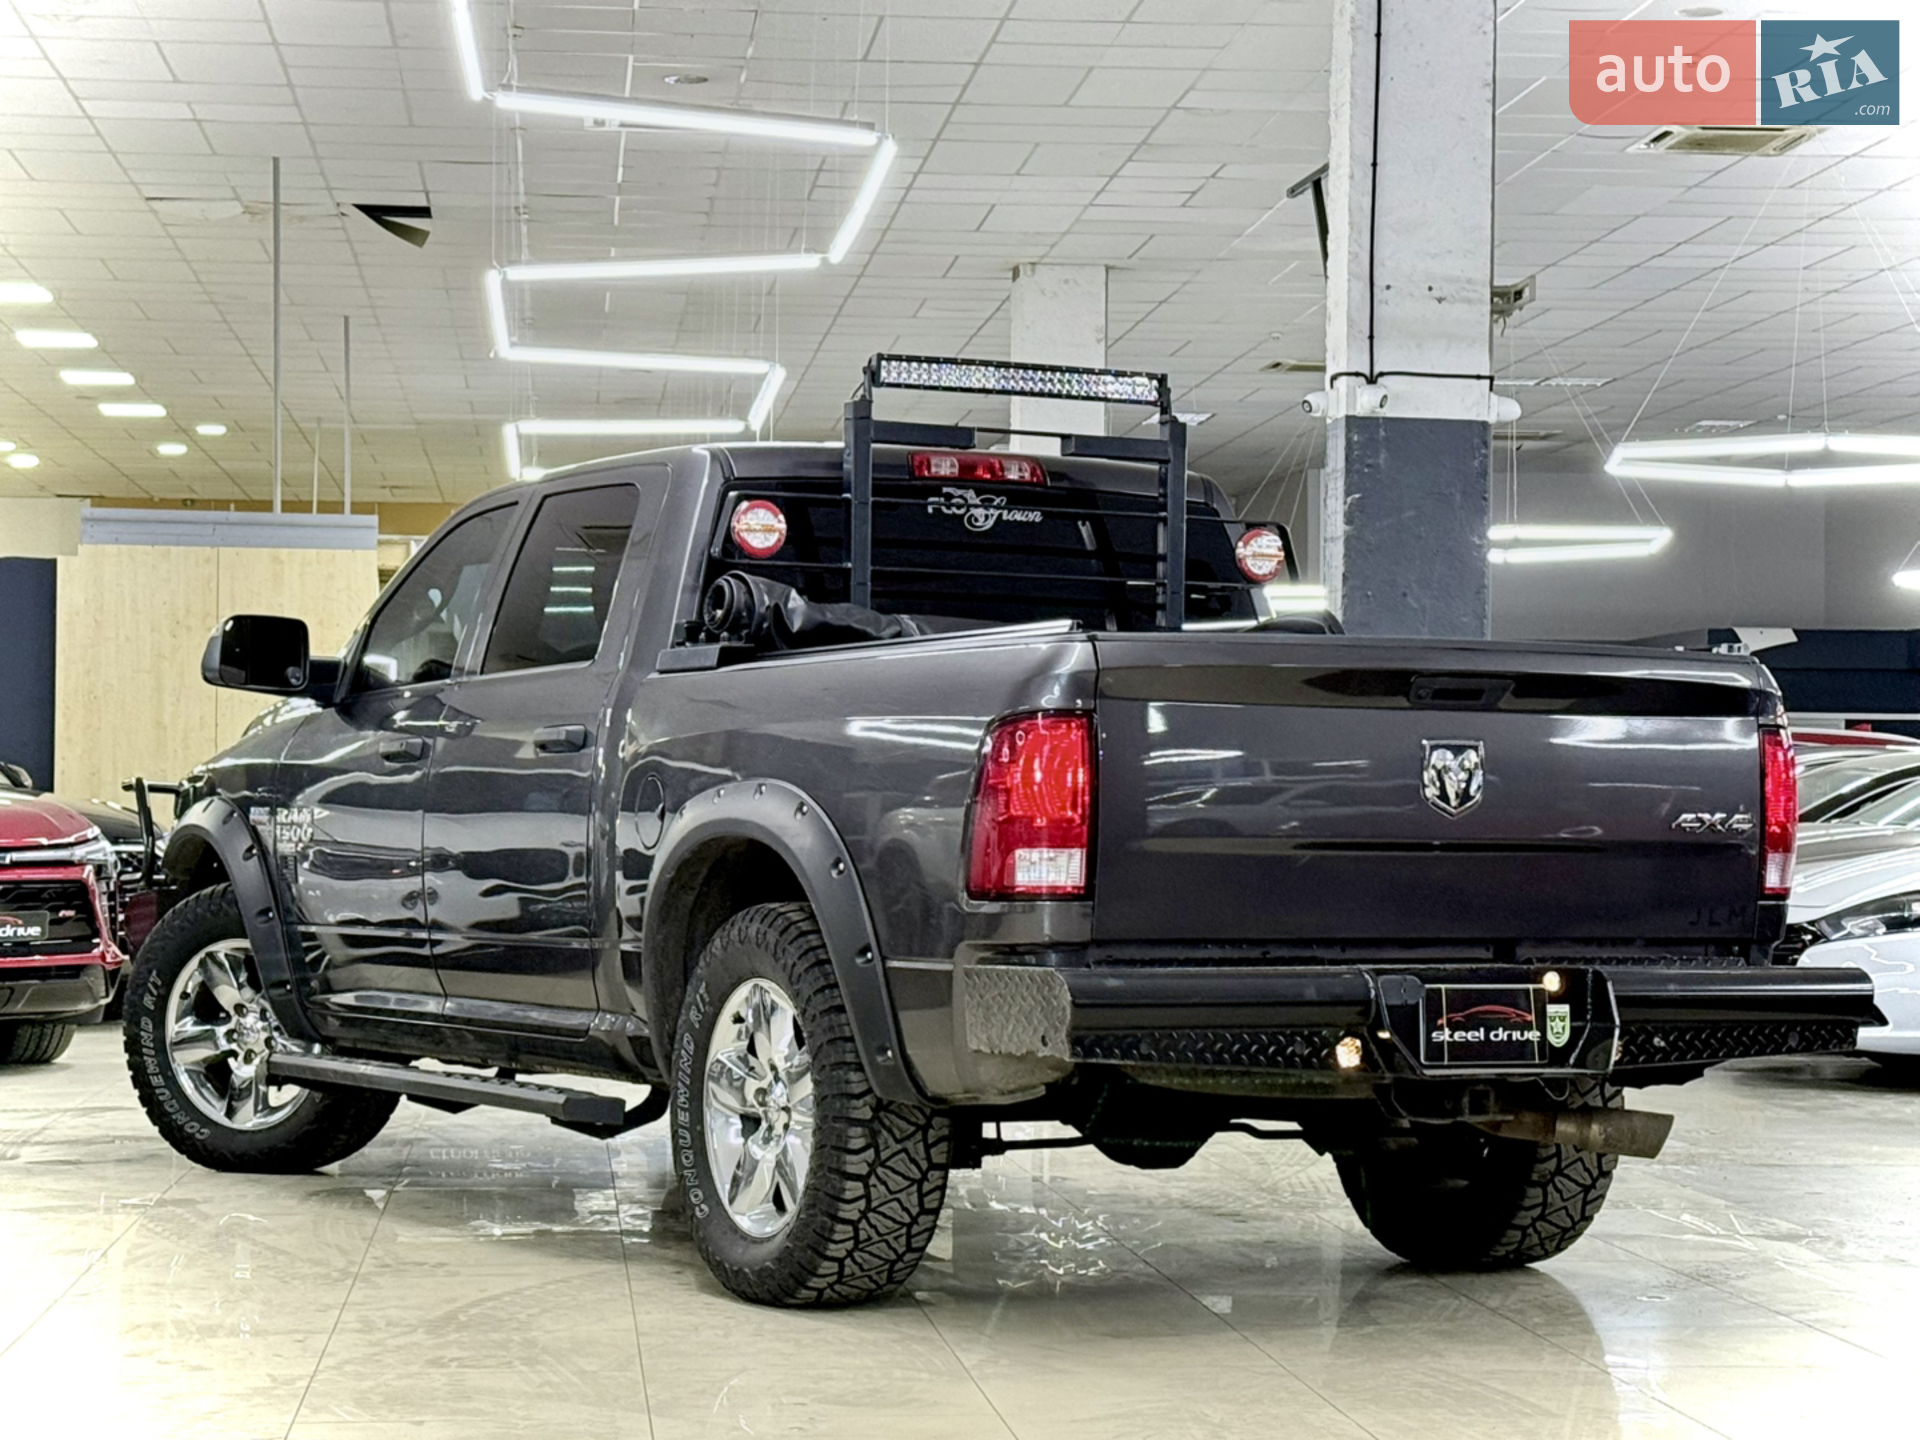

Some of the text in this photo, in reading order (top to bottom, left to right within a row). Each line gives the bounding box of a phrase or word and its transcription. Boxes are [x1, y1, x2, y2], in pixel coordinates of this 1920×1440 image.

[276, 807, 313, 823] RAM
[1431, 1027, 1541, 1042] steel drive
[140, 1016, 211, 1140] CONQUEWIND
[676, 1032, 709, 1219] CONQUEWIND
